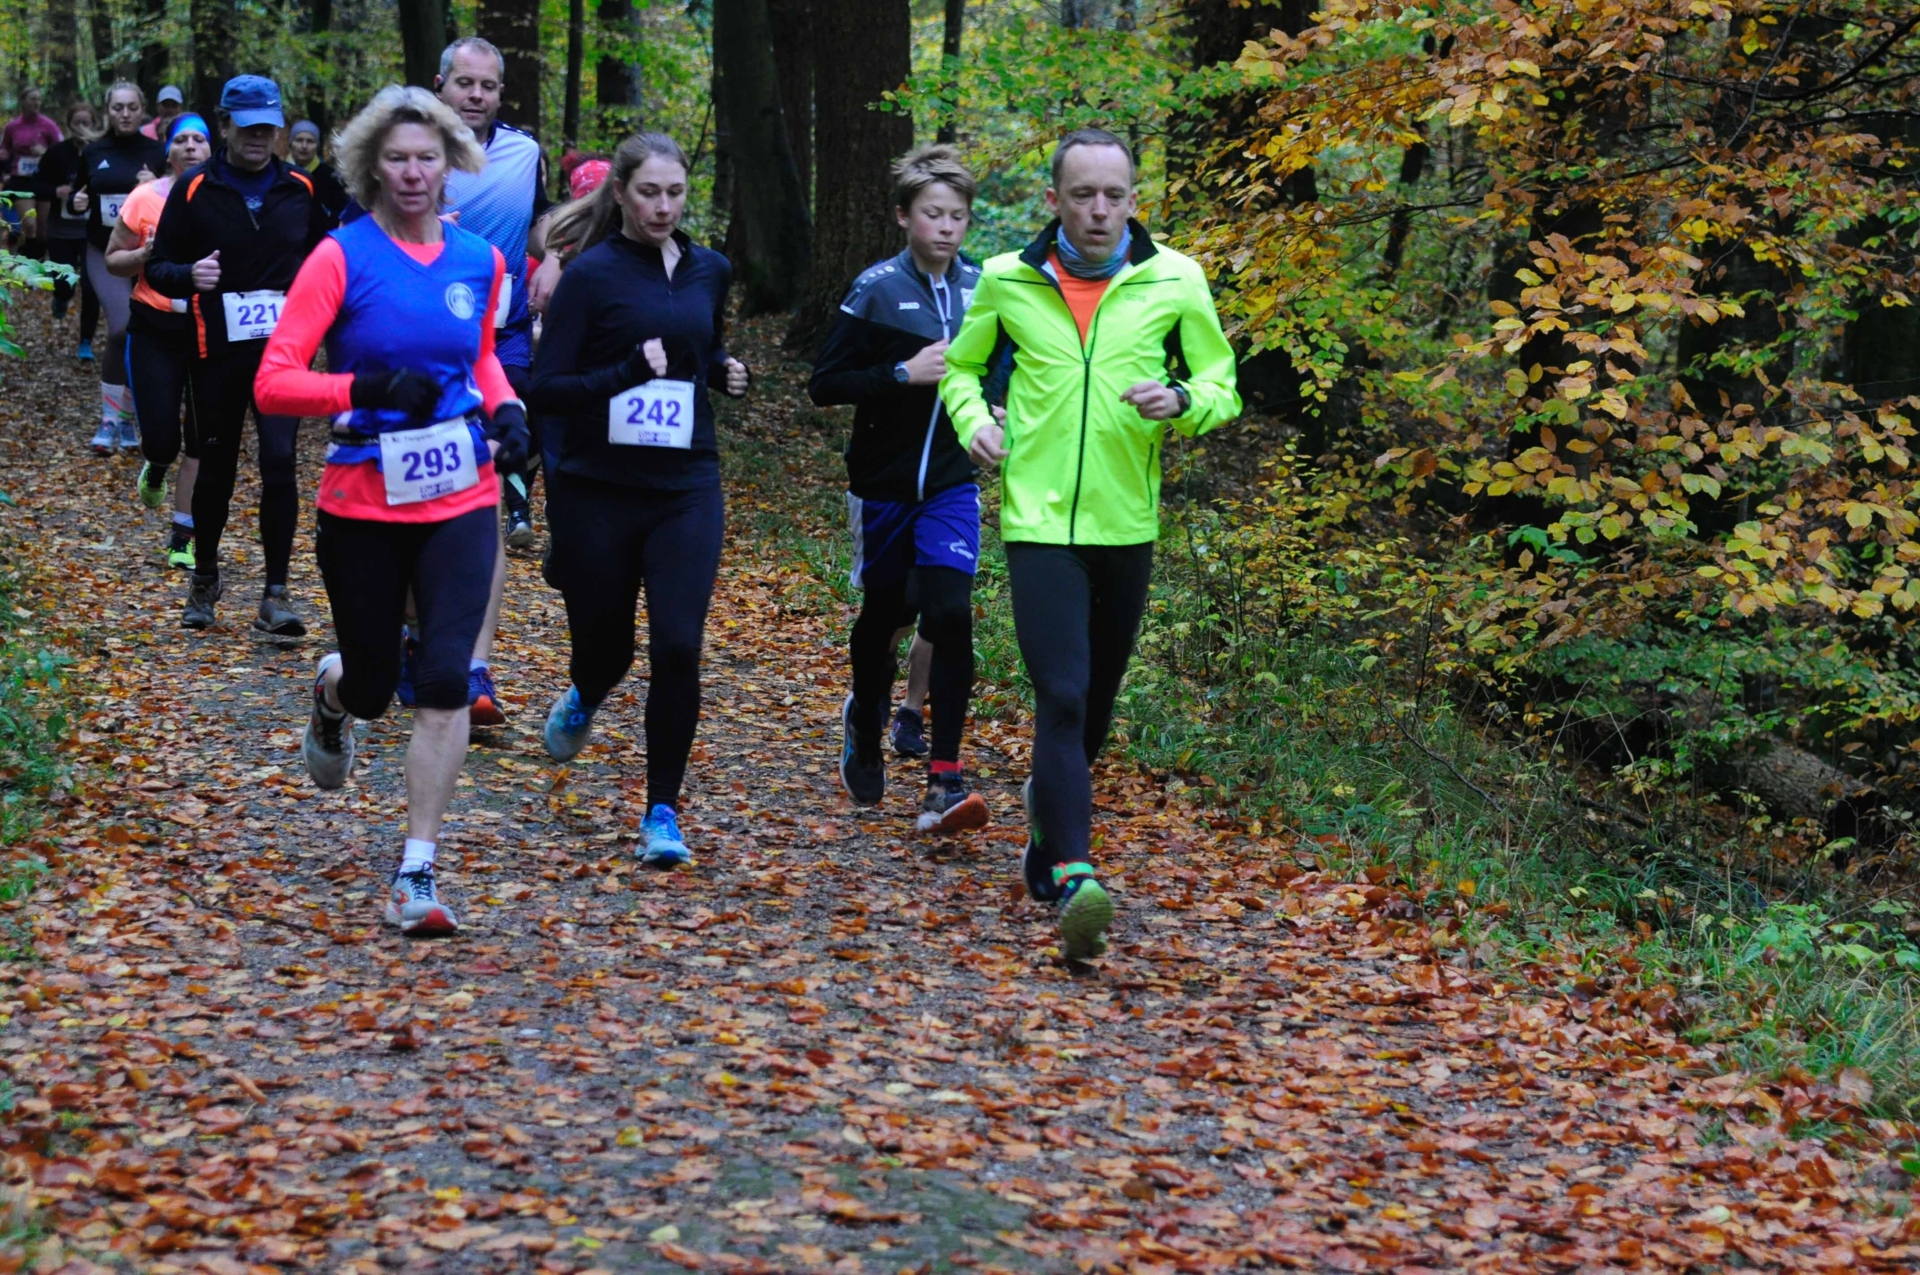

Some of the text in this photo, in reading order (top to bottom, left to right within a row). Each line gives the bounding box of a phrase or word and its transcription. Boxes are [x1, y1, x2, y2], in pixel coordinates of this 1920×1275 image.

[237, 303, 278, 326] 221
[626, 397, 681, 427] 242
[401, 441, 461, 482] 293
